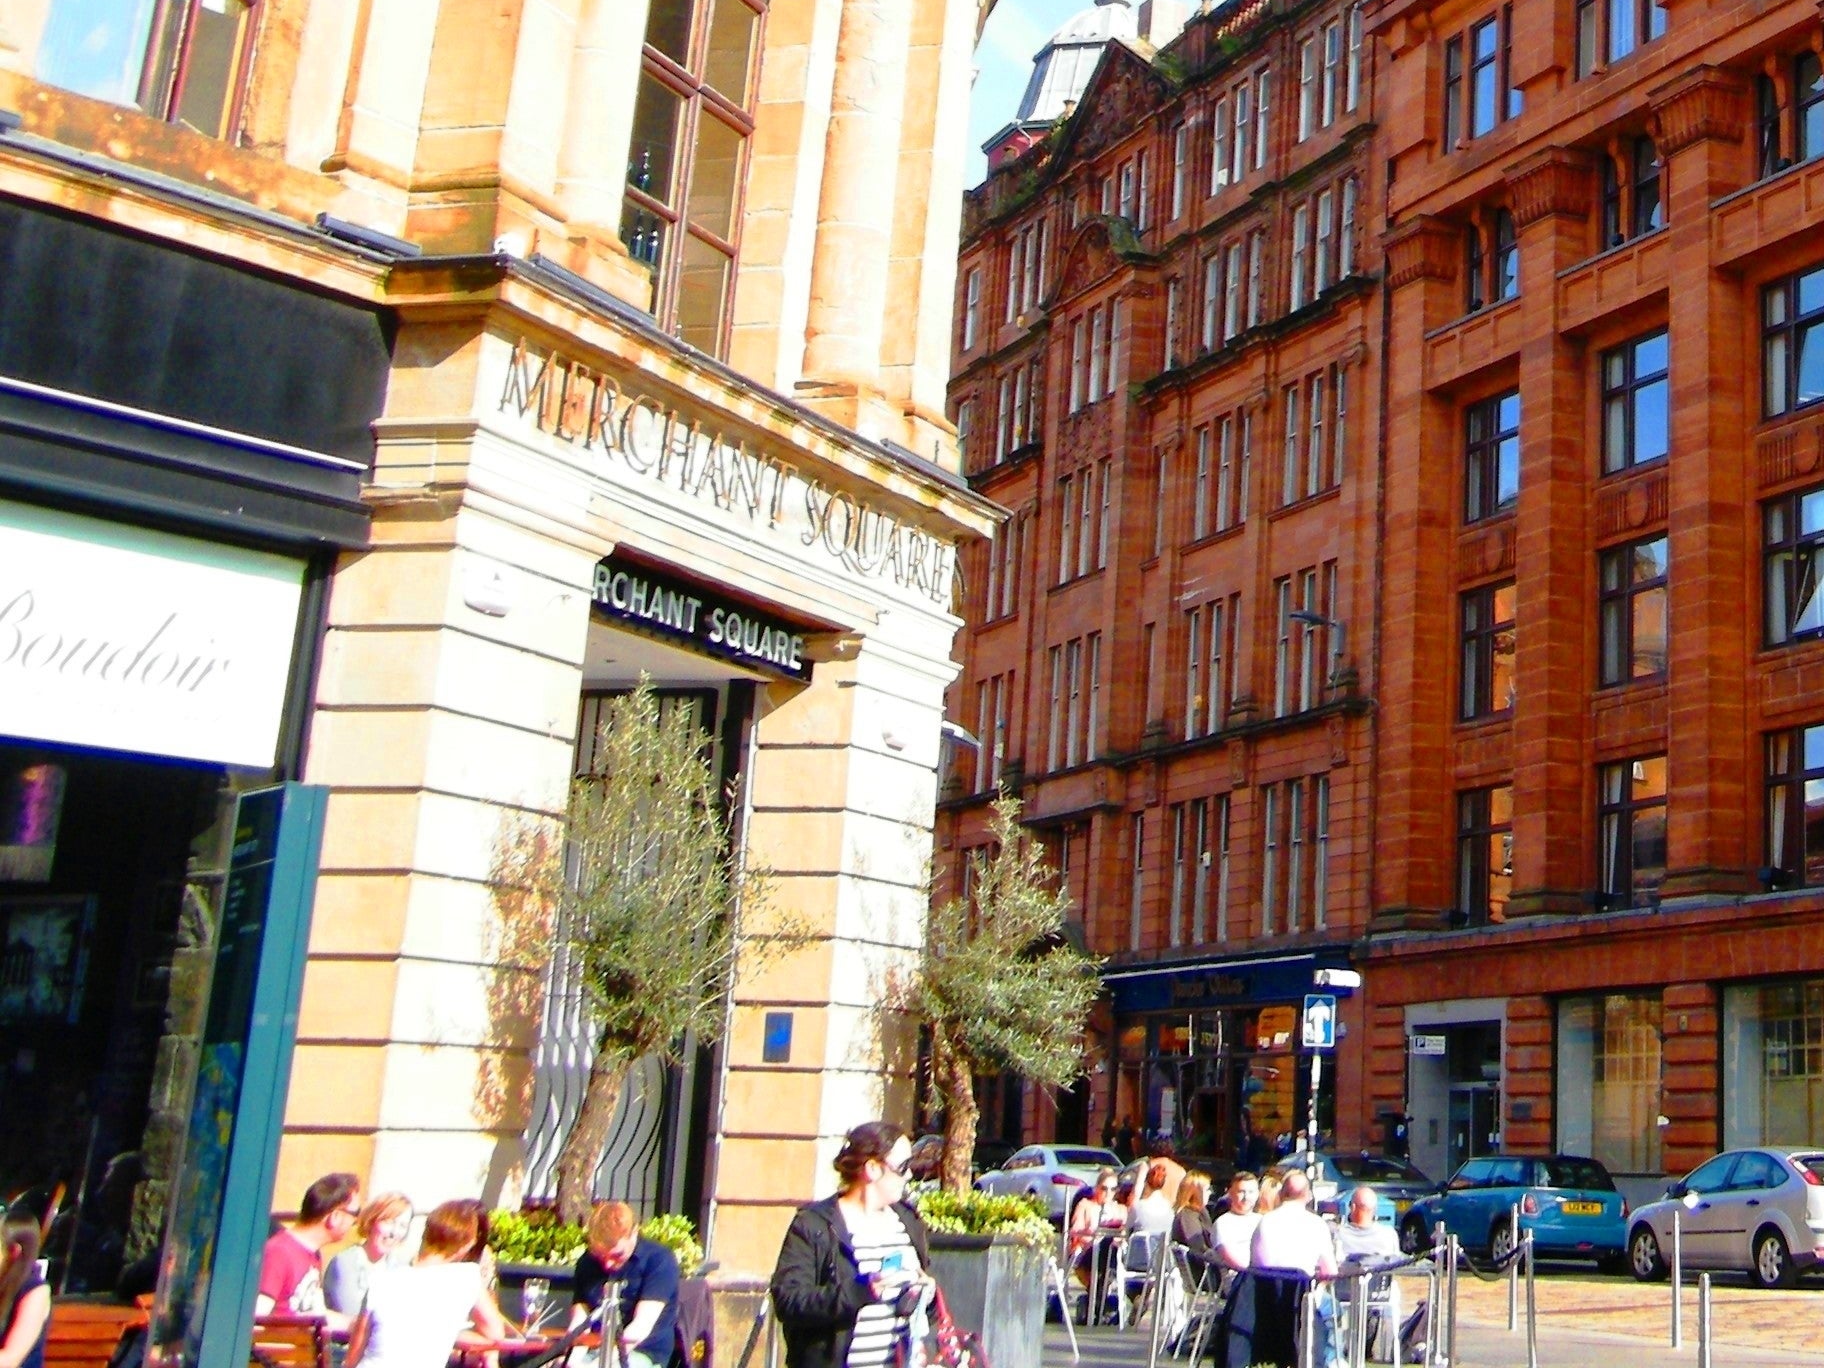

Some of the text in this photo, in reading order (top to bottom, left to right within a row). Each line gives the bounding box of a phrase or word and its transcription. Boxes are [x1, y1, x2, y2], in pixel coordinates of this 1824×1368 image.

[498, 336, 958, 605] MERCHANT SQUARE
[709, 606, 803, 671] SQUARE
